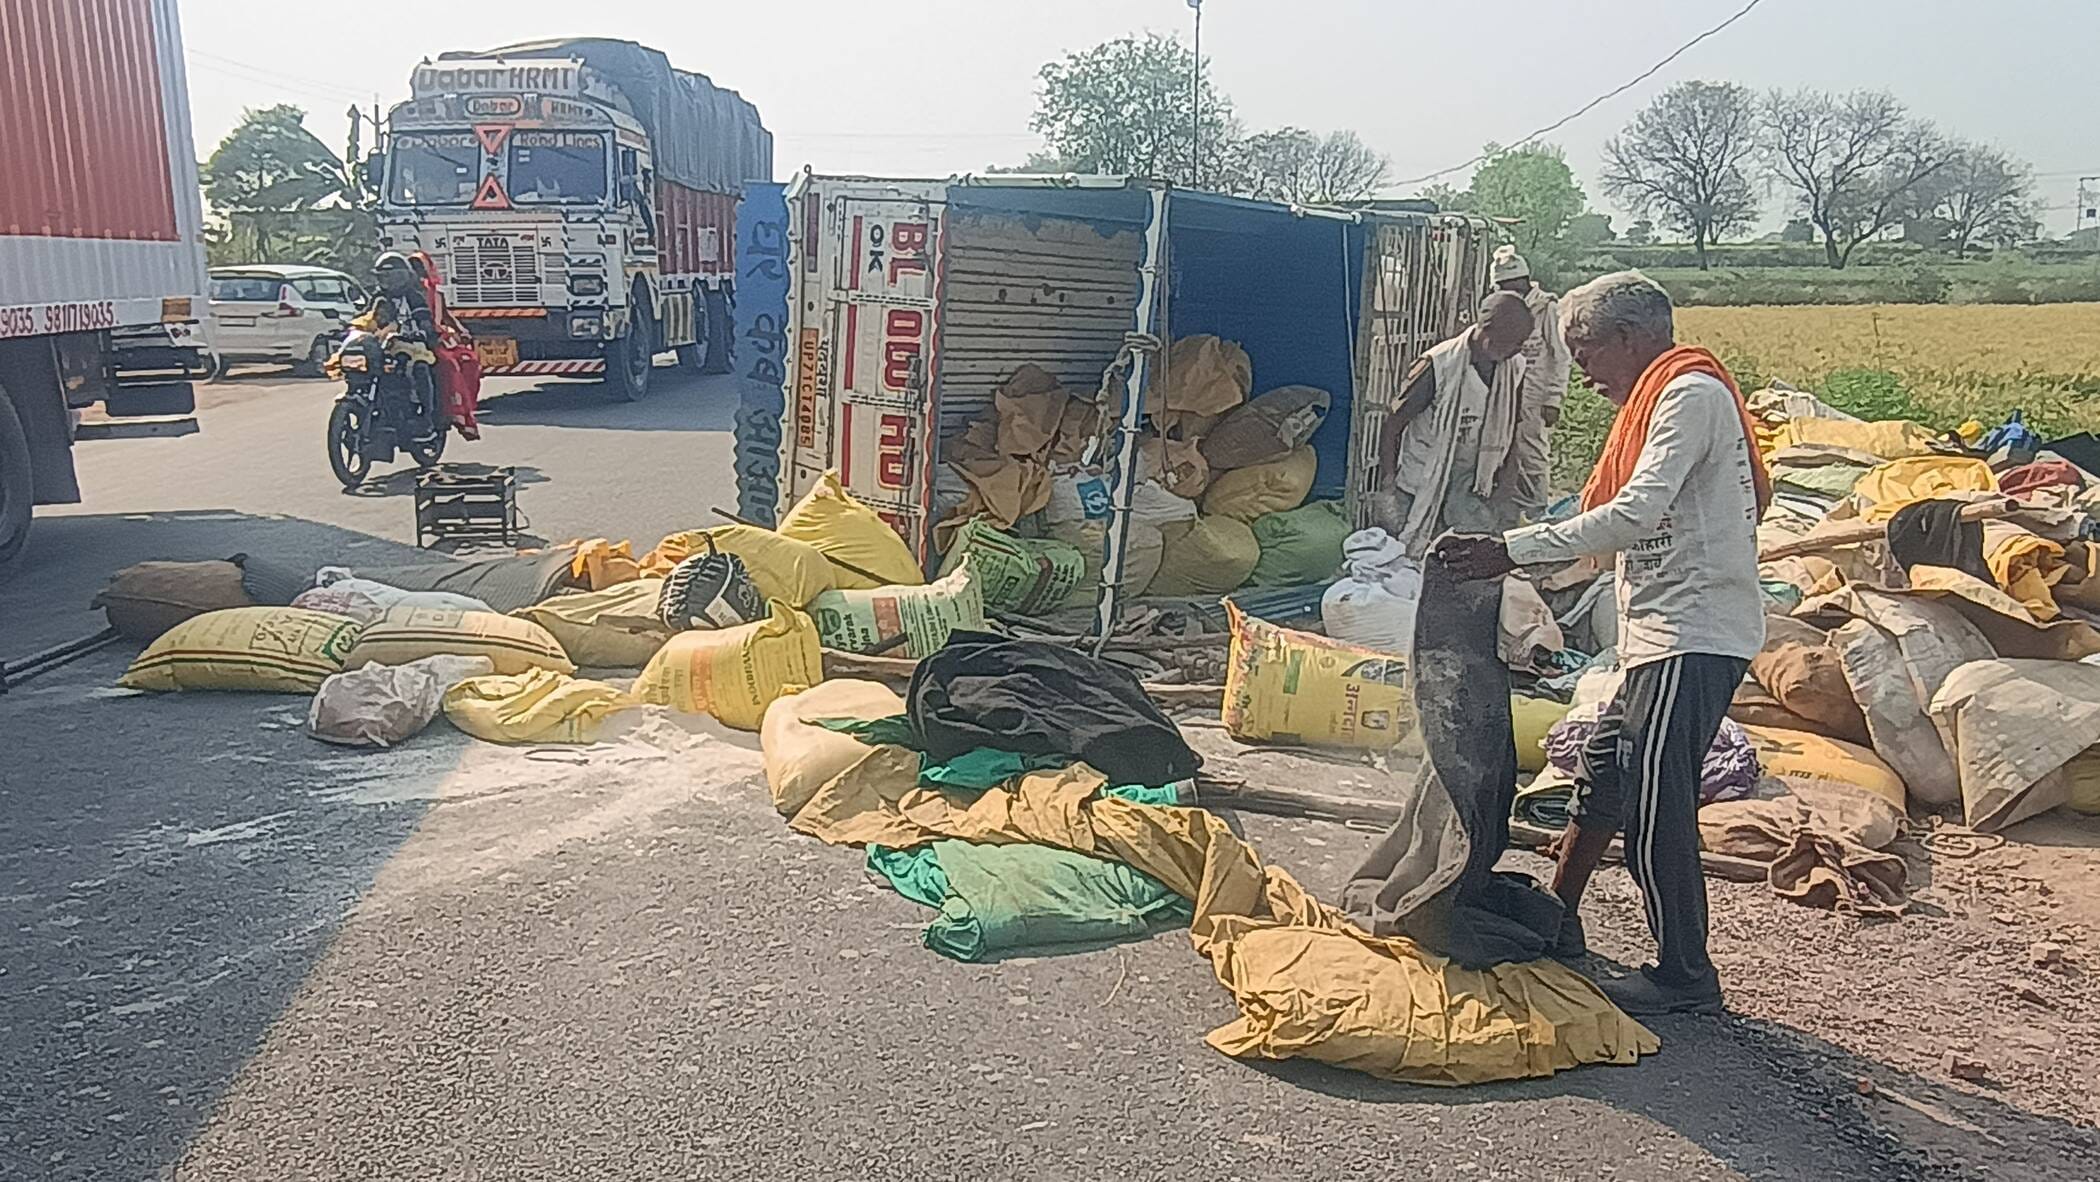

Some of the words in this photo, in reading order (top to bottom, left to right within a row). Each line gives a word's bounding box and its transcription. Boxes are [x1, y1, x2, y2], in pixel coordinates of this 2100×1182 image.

[508, 67, 576, 90] HRMT
[476, 236, 510, 249] TATA
[867, 223, 884, 274] OK
